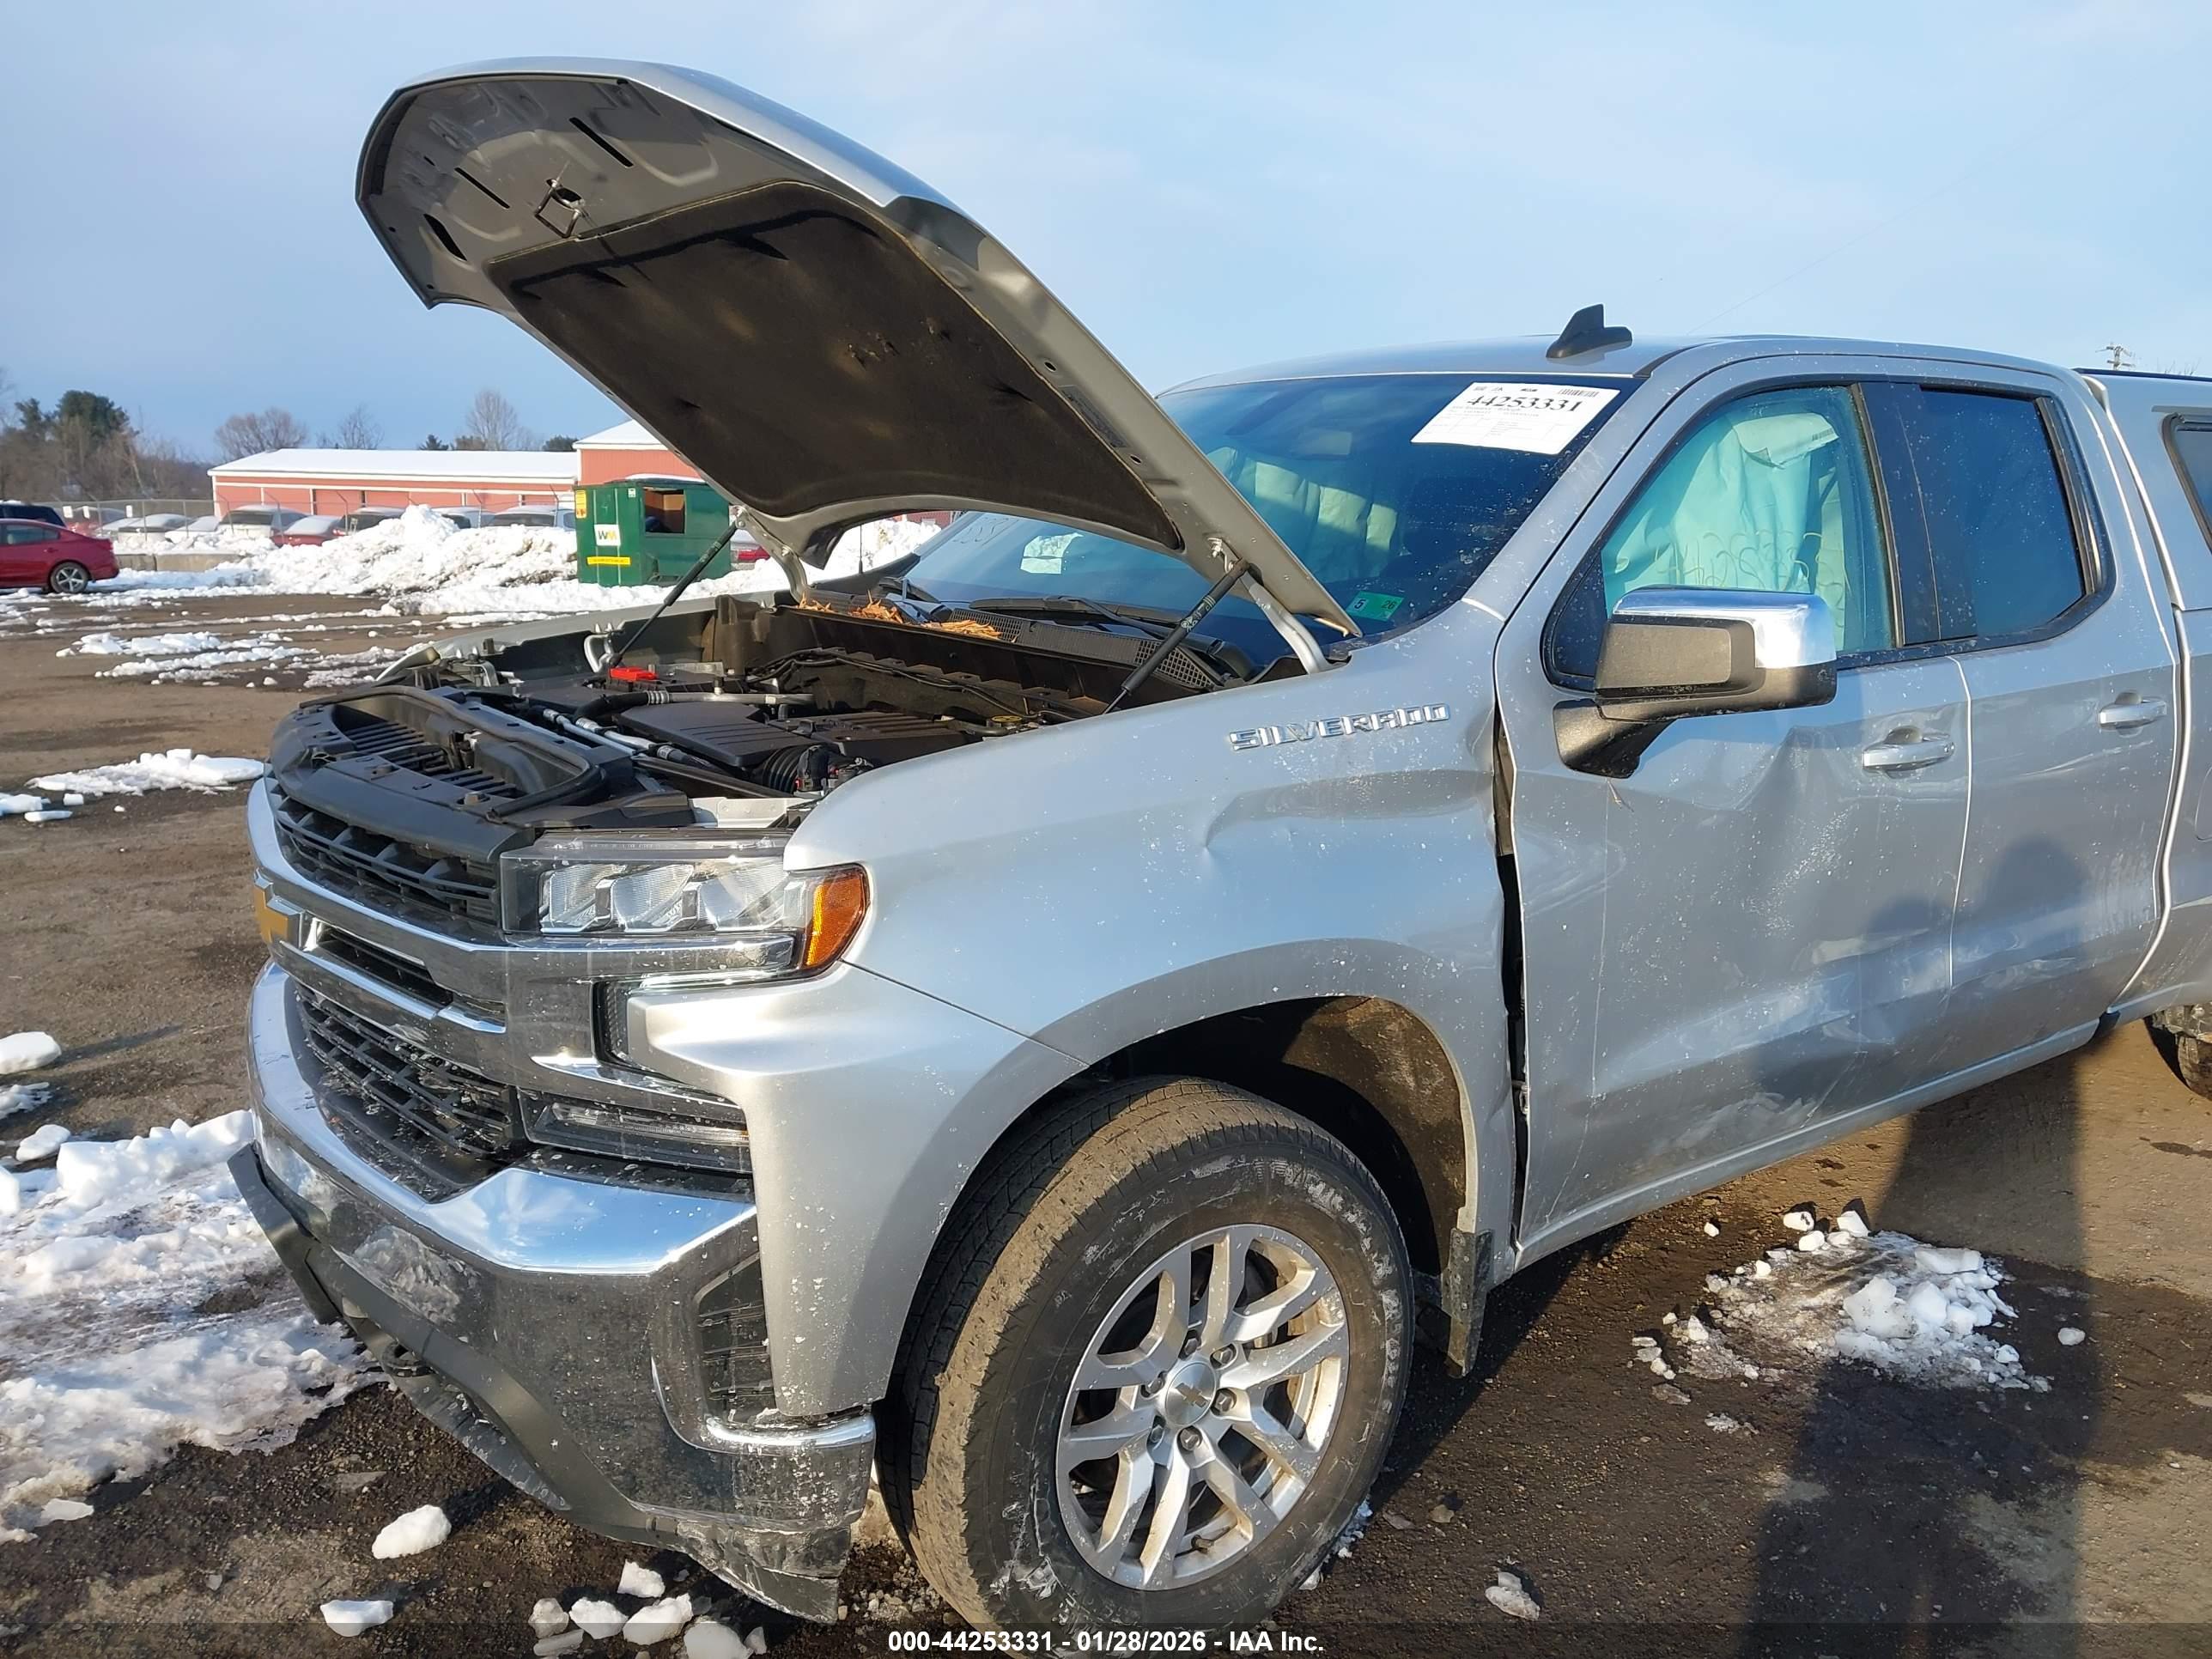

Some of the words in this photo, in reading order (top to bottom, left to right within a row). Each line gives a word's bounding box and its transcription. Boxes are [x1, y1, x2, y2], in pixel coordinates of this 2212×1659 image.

[1467, 395, 1583, 412] 44253331
[1354, 599, 1366, 610] 5
[1382, 599, 1396, 610] 26
[1229, 702, 1450, 751] SILVERADO
